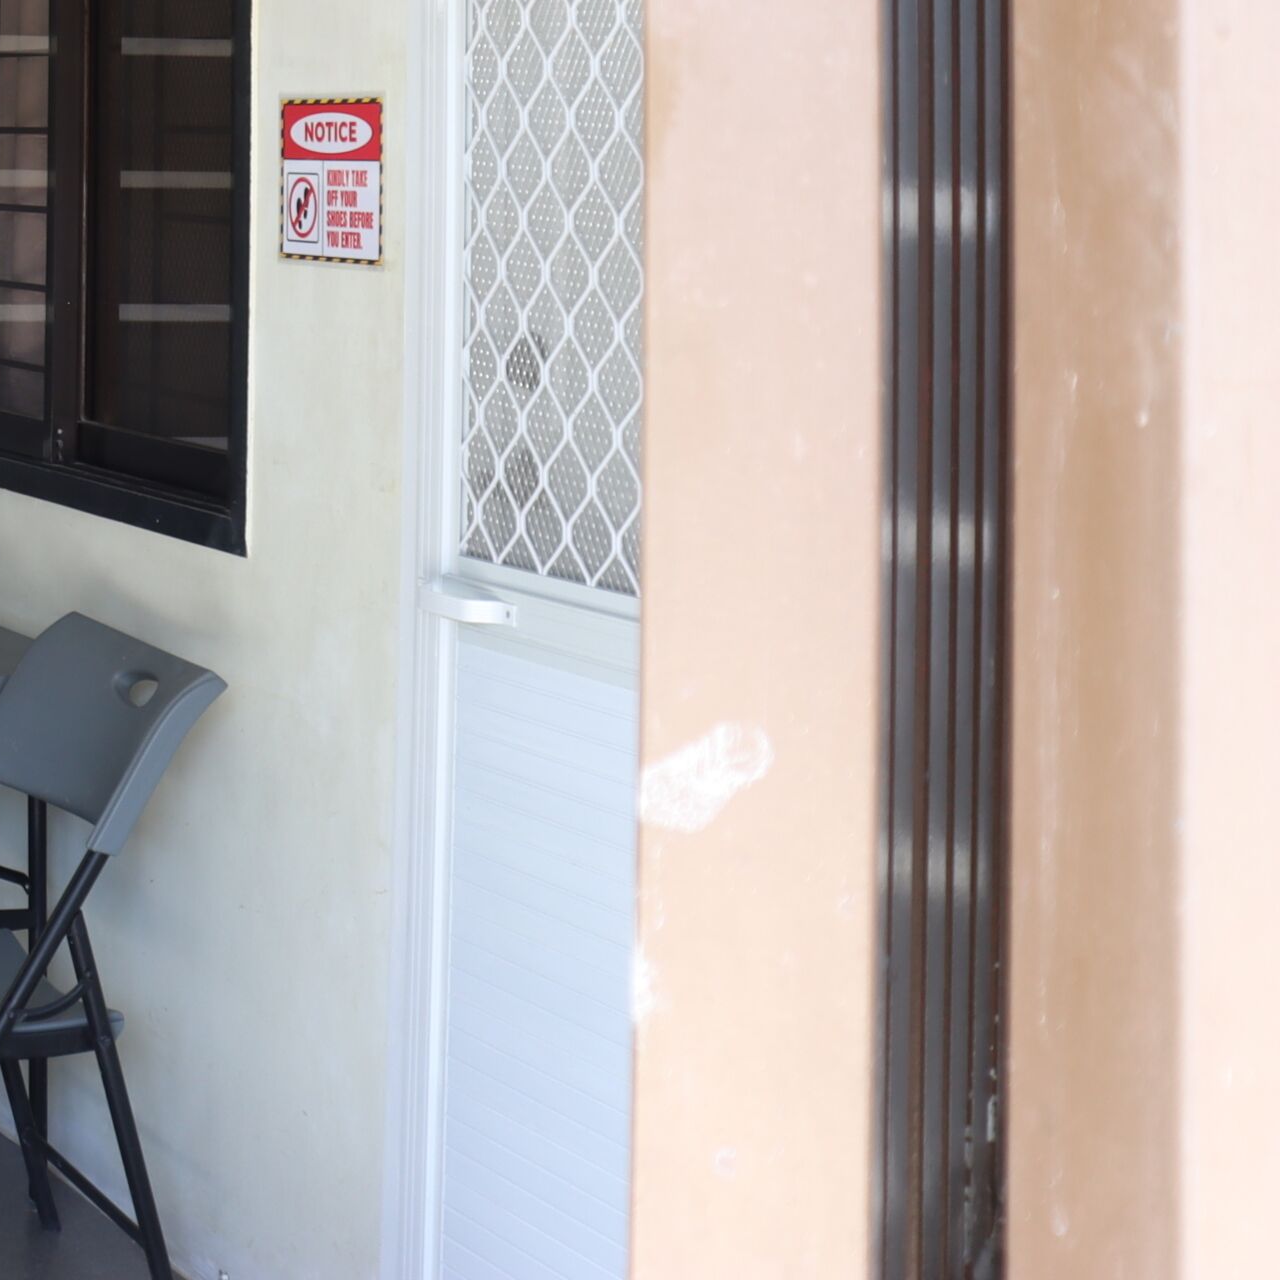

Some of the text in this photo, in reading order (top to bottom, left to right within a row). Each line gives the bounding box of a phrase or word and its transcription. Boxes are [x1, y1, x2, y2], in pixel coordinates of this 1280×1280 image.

[304, 121, 357, 143] NOTICE
[327, 169, 368, 187] KINDLY TAKE
[327, 190, 358, 207] OFF YOUR
[327, 210, 373, 229] SHOES BEFORE
[327, 231, 339, 248] YOU
